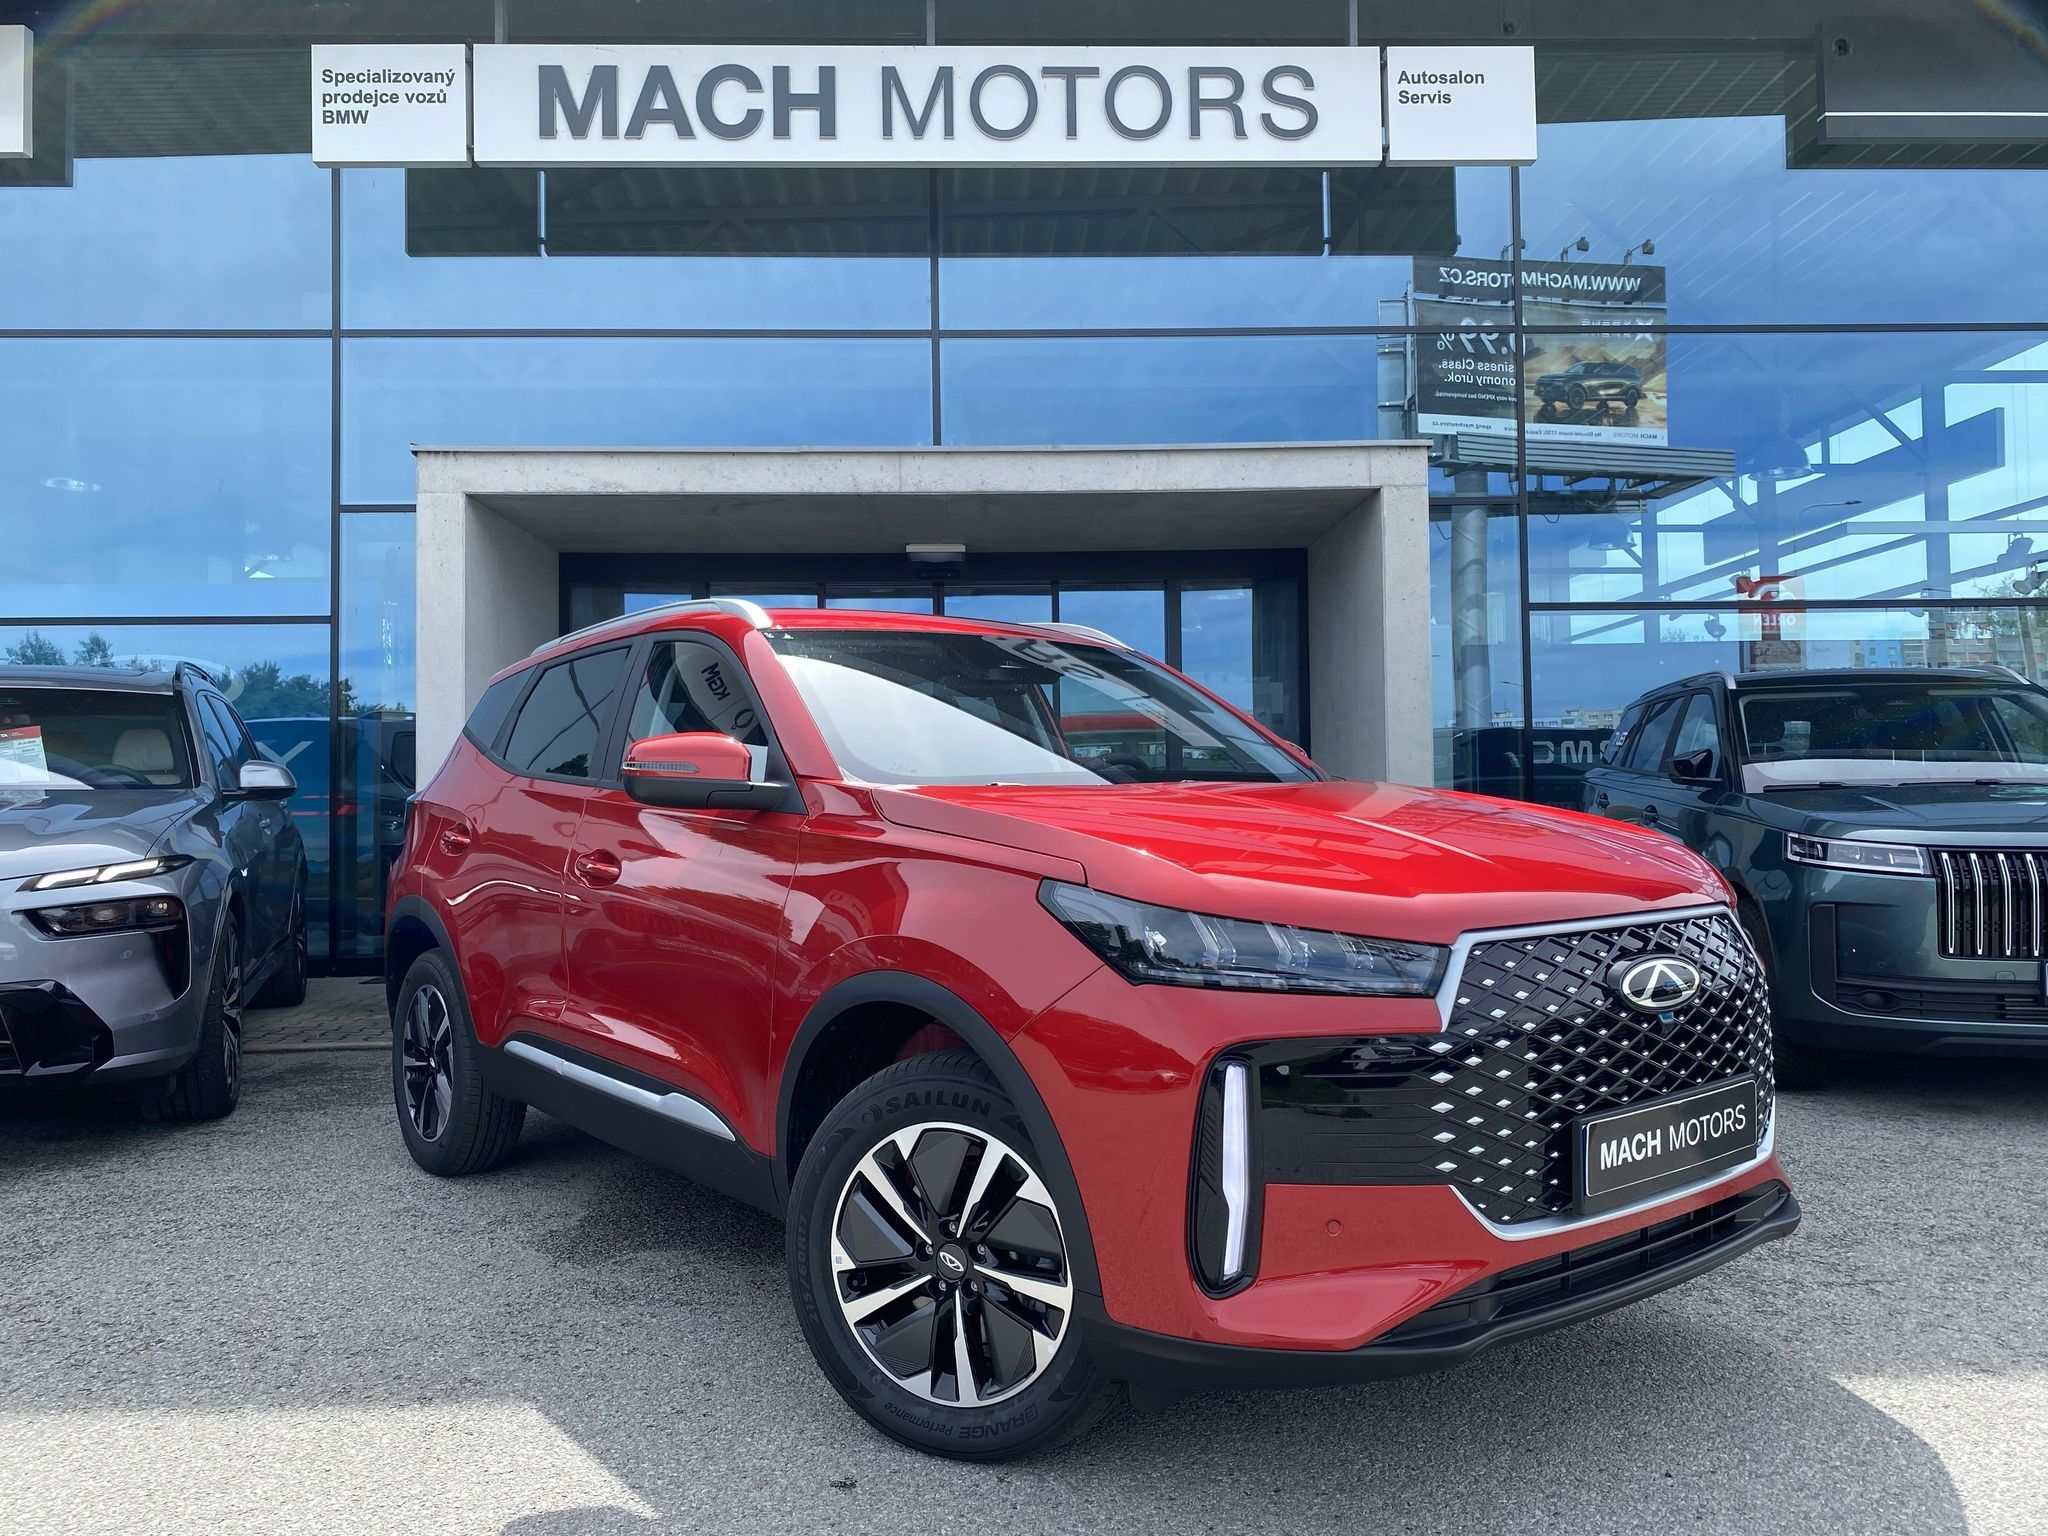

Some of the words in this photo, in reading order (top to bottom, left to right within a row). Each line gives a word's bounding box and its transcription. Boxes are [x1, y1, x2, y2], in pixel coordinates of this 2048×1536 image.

[321, 67, 456, 87] Specializovaný
[1397, 69, 1485, 86] Autosalon
[321, 89, 399, 108] prodejce
[404, 87, 447, 104] vozů
[538, 63, 837, 140] MACH
[881, 64, 1319, 140] MOTORS
[1398, 90, 1452, 105] Servis
[321, 109, 369, 125] BMW
[885, 1089, 993, 1117] SAILUN
[1600, 1128, 1661, 1171] MACH
[1669, 1103, 1746, 1152] MOTORS
[884, 1401, 953, 1438] Performance
